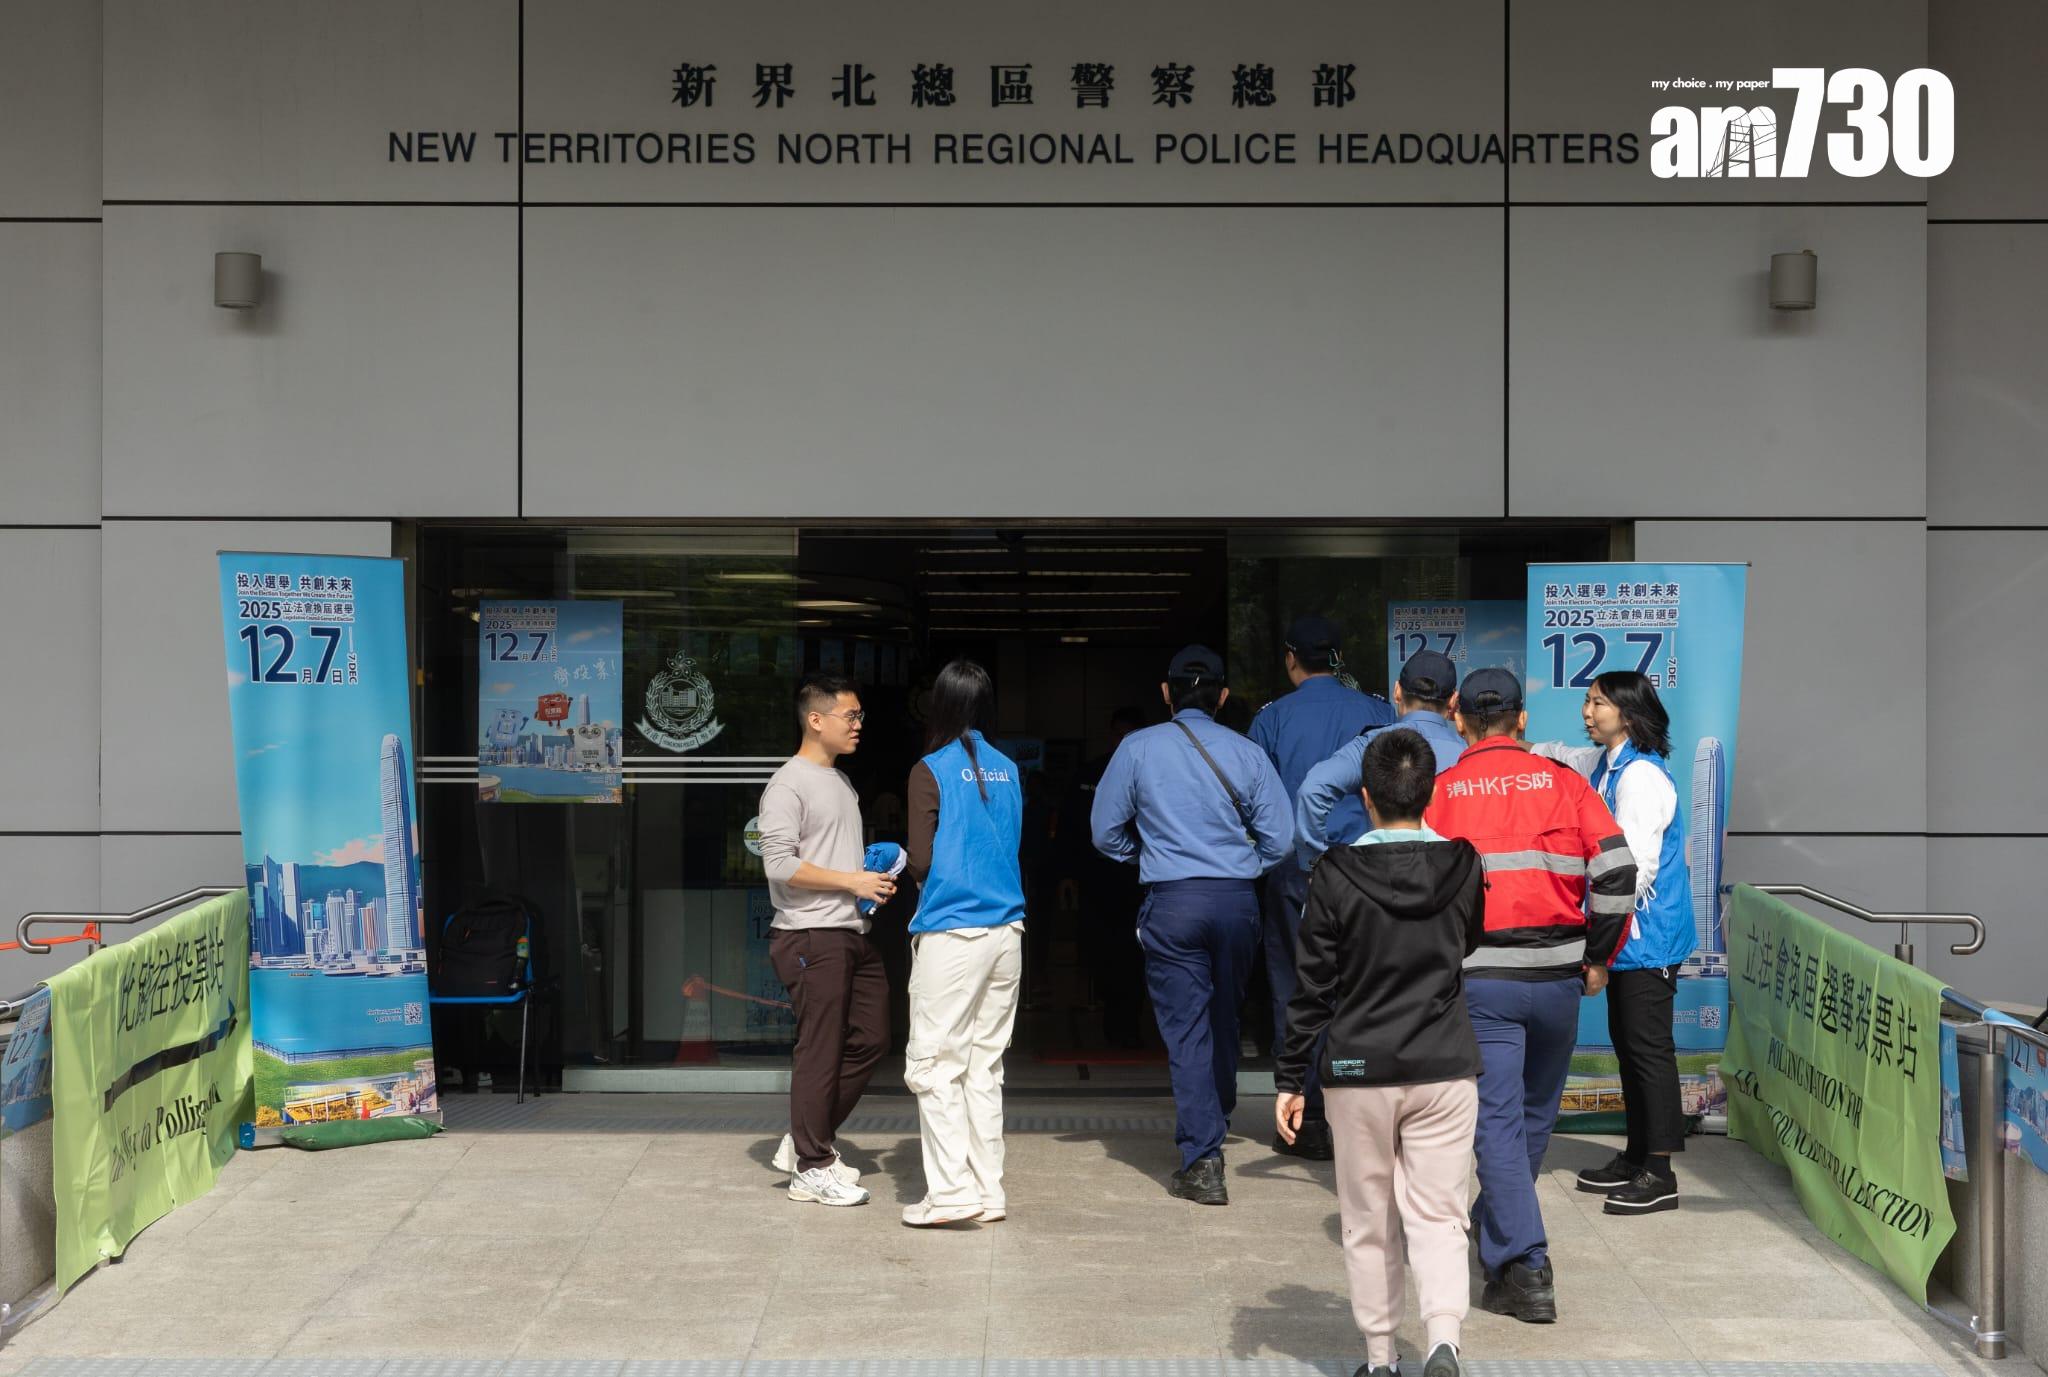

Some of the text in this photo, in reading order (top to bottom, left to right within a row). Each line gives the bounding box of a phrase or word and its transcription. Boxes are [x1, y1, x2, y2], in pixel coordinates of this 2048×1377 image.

[671, 63, 1357, 108] 新界北總區警察總部
[388, 131, 1640, 165] NEW TERRITORIES NORTH REGIONAL POLICE HEADQUARTERS
[1545, 583, 1679, 598] 投入選舉 共創未來
